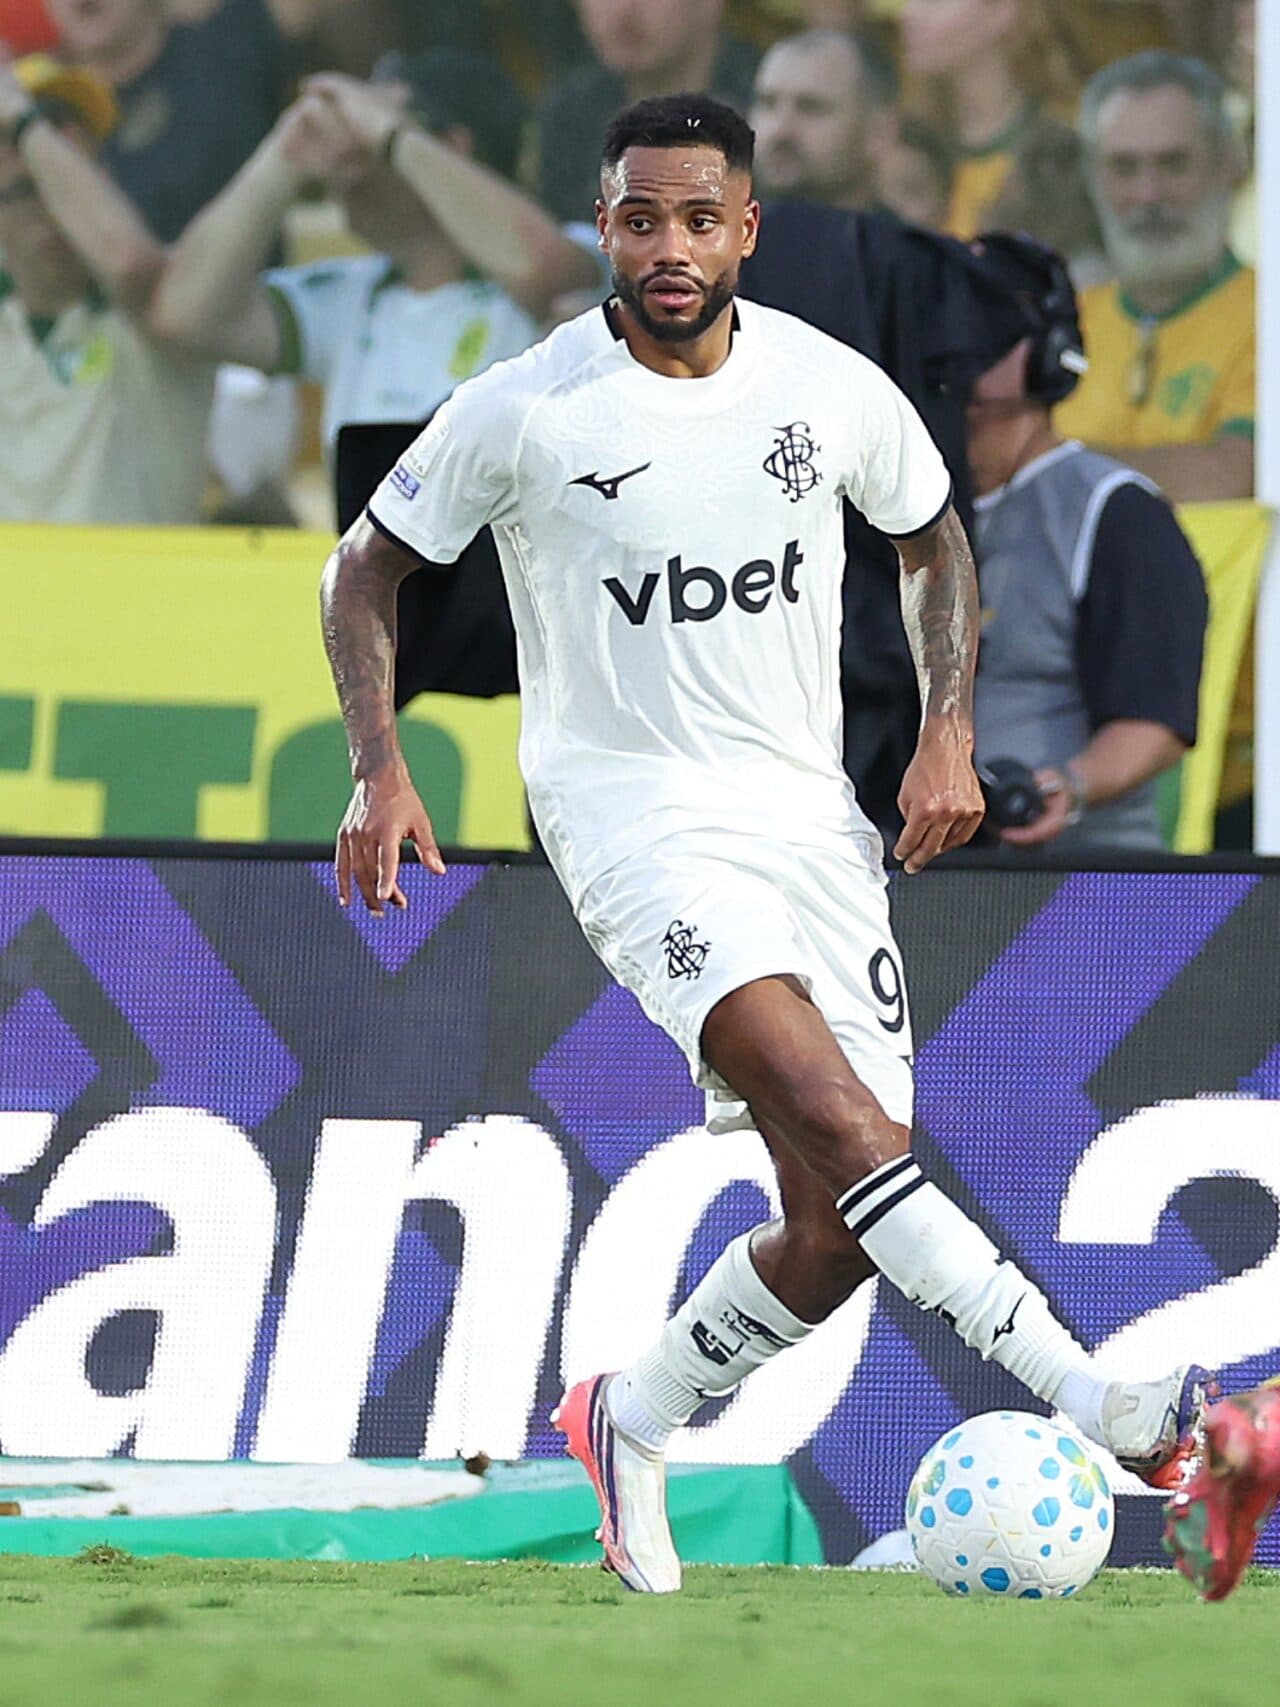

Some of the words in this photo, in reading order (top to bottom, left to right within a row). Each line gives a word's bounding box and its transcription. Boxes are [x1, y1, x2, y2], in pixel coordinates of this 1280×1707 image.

[601, 538, 804, 626] vbet
[868, 947, 904, 1034] 9
[0, 1105, 878, 1465] ano
